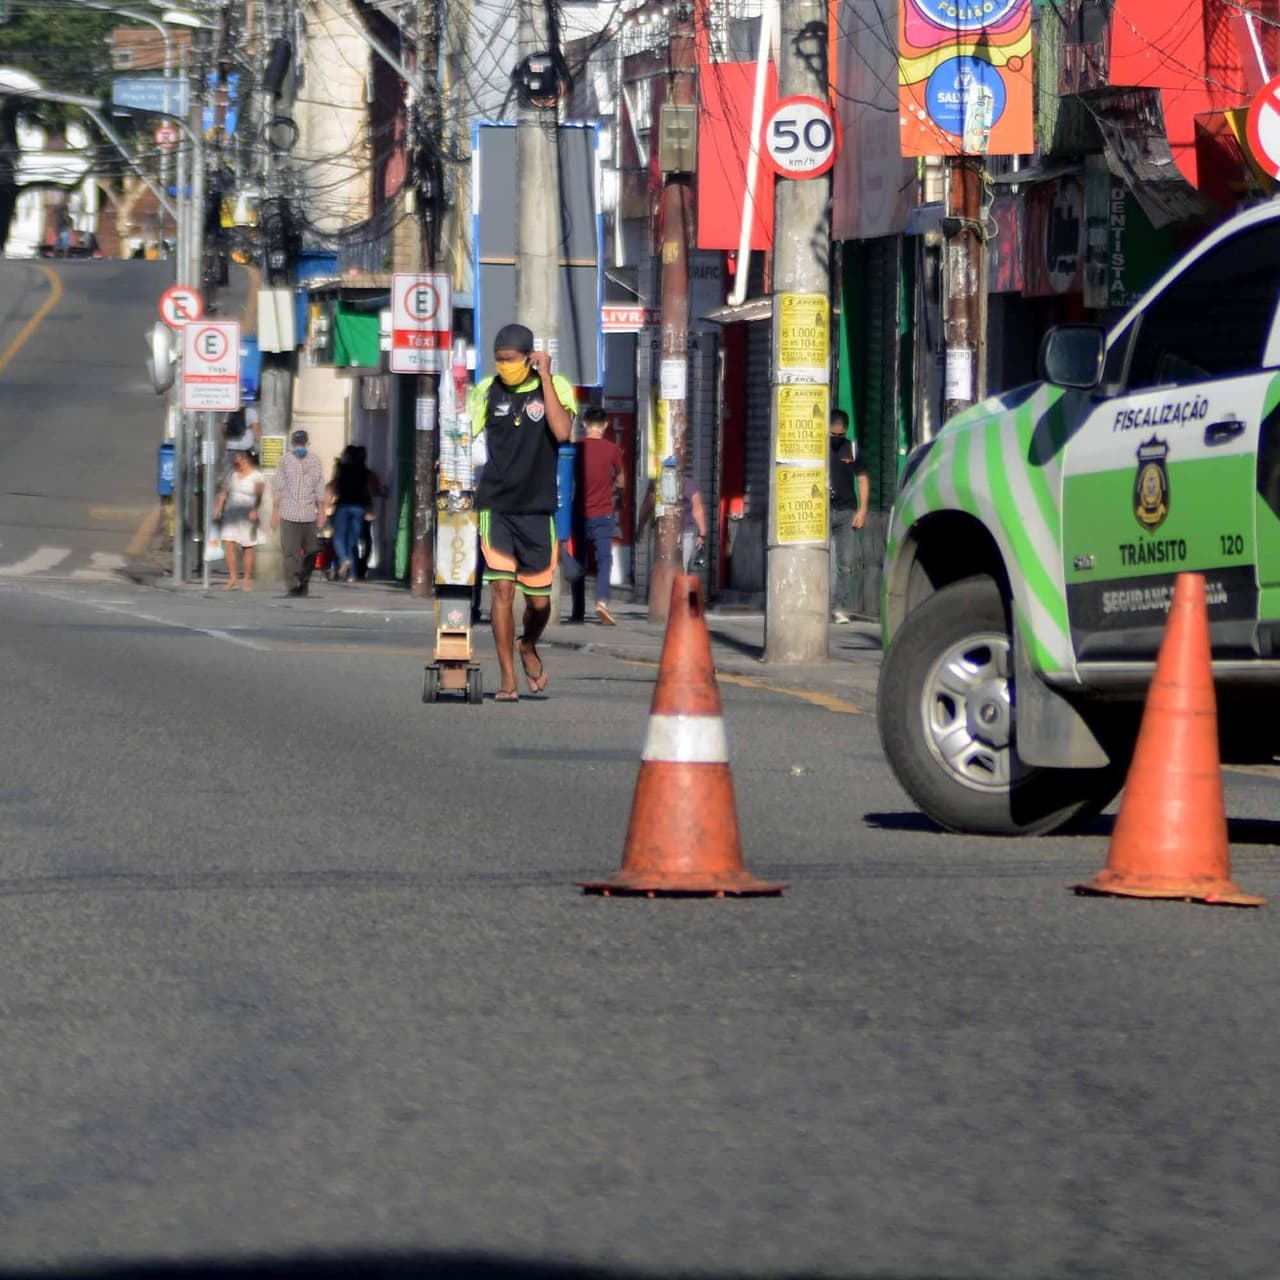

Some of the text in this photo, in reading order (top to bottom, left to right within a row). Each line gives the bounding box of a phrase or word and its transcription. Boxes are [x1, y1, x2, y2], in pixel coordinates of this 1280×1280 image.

[774, 119, 832, 154] 50
[789, 158, 815, 166] km/h
[1110, 187, 1127, 292] DENTISTA
[1114, 395, 1209, 431] FISCALIZAÇÃO
[1119, 537, 1187, 567] TRÂNSITO
[1220, 534, 1245, 556] 120
[1102, 587, 1175, 614] SEGURANÇ
